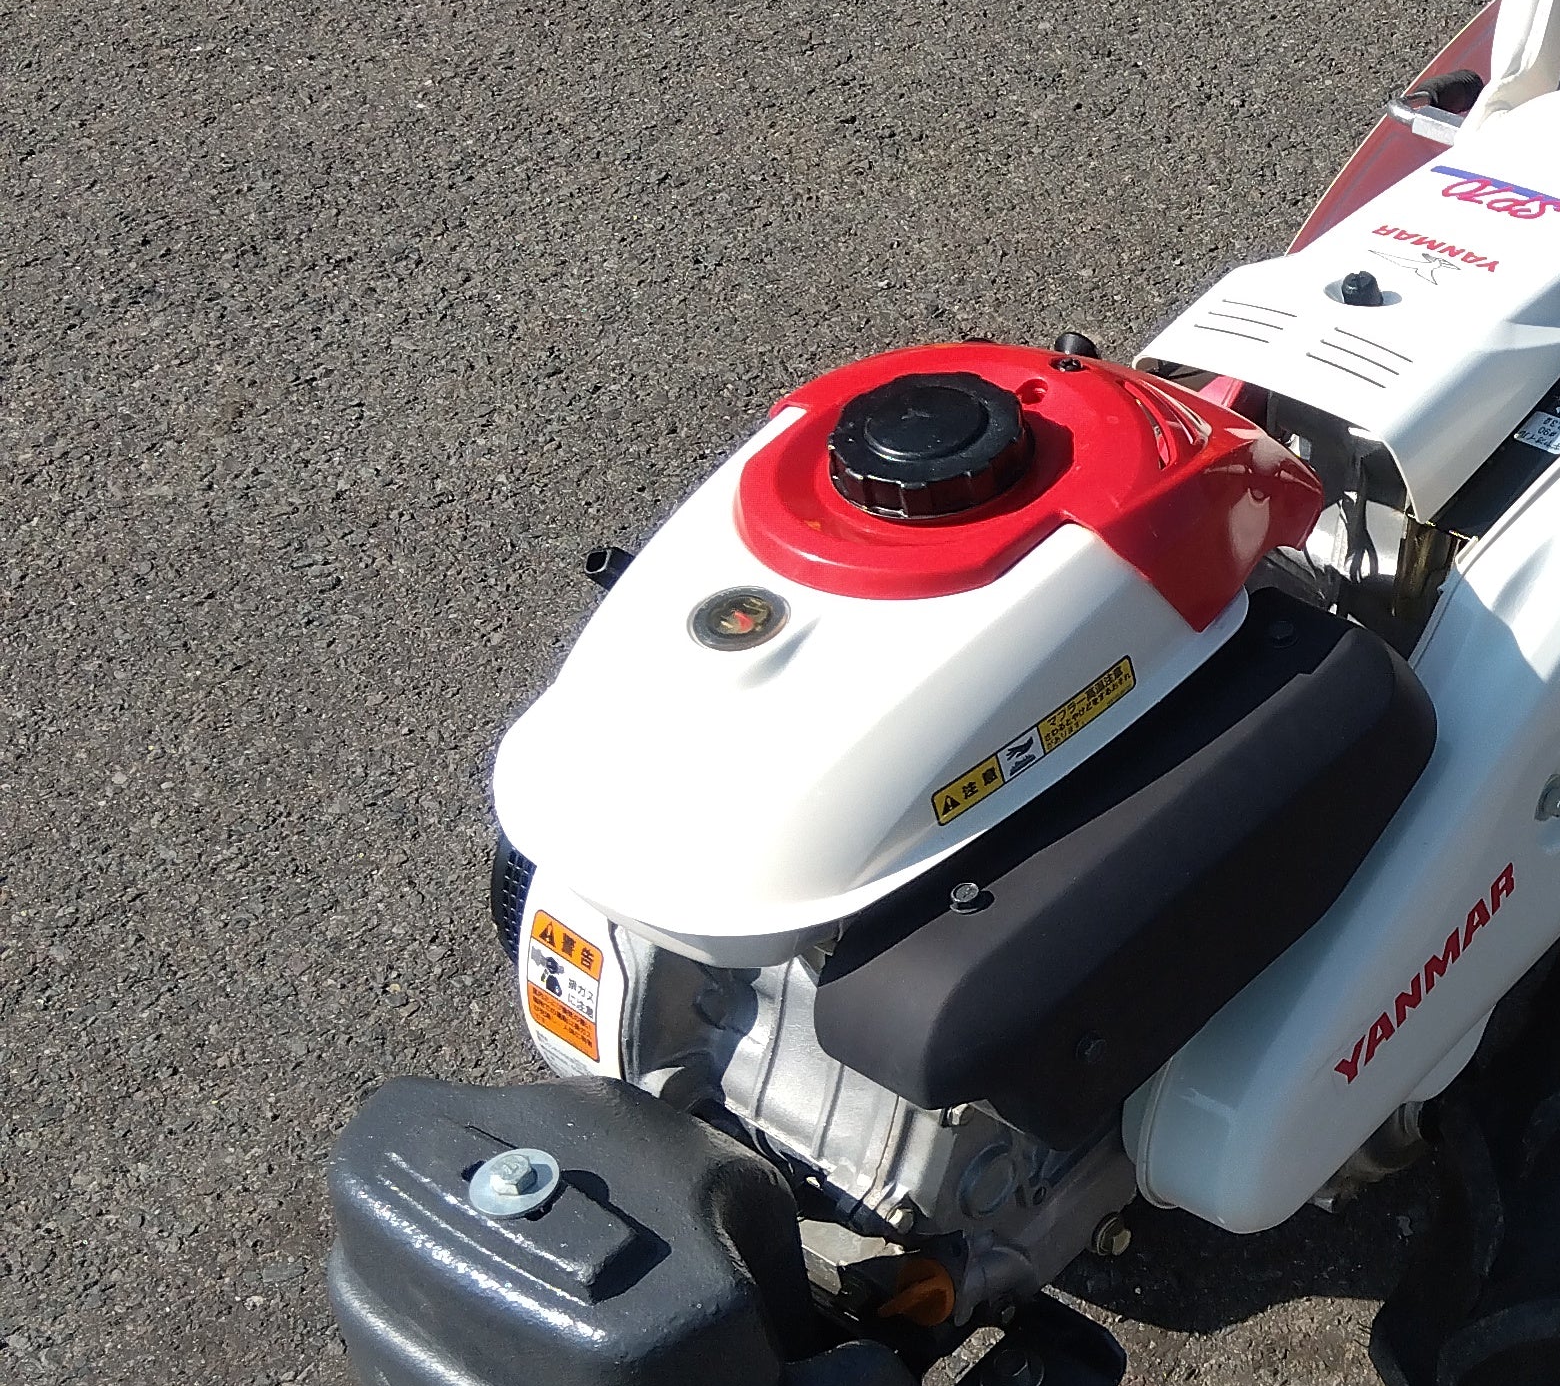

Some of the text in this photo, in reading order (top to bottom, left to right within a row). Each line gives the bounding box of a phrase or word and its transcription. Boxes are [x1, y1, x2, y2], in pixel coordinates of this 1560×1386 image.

[1372, 224, 1500, 273] YANMAR
[961, 766, 998, 800] 注意
[561, 932, 595, 971] 警告
[1334, 862, 1515, 1084] YANMAR
